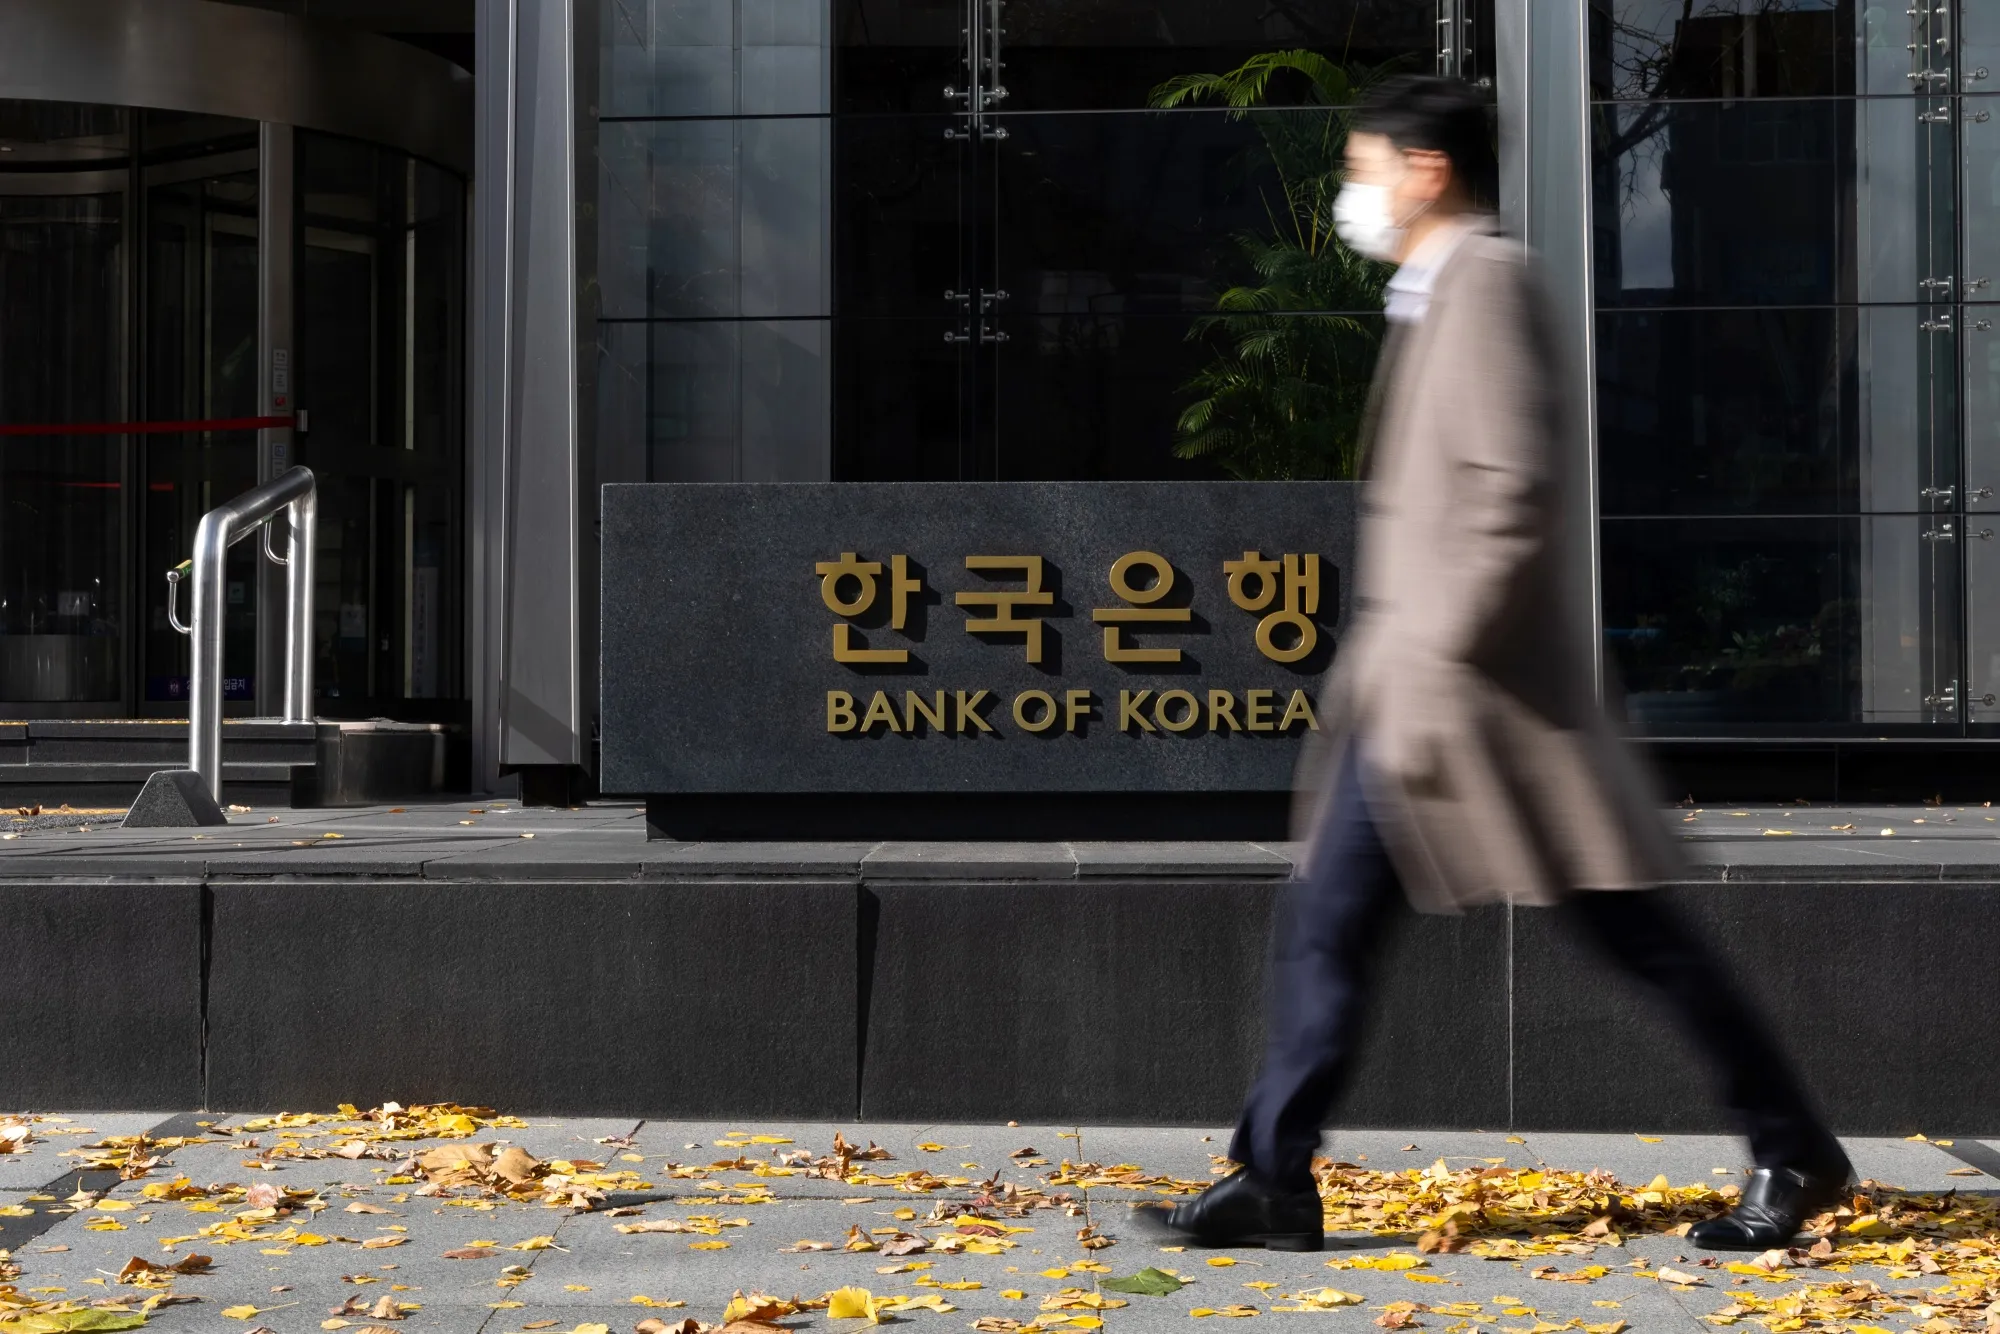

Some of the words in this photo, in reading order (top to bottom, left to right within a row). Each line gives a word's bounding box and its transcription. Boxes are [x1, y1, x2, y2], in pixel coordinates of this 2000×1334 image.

[815, 551, 1320, 664] 한국은행
[826, 690, 993, 733] BANK
[1012, 689, 1091, 733] OF
[1119, 689, 1320, 732] KOREA
